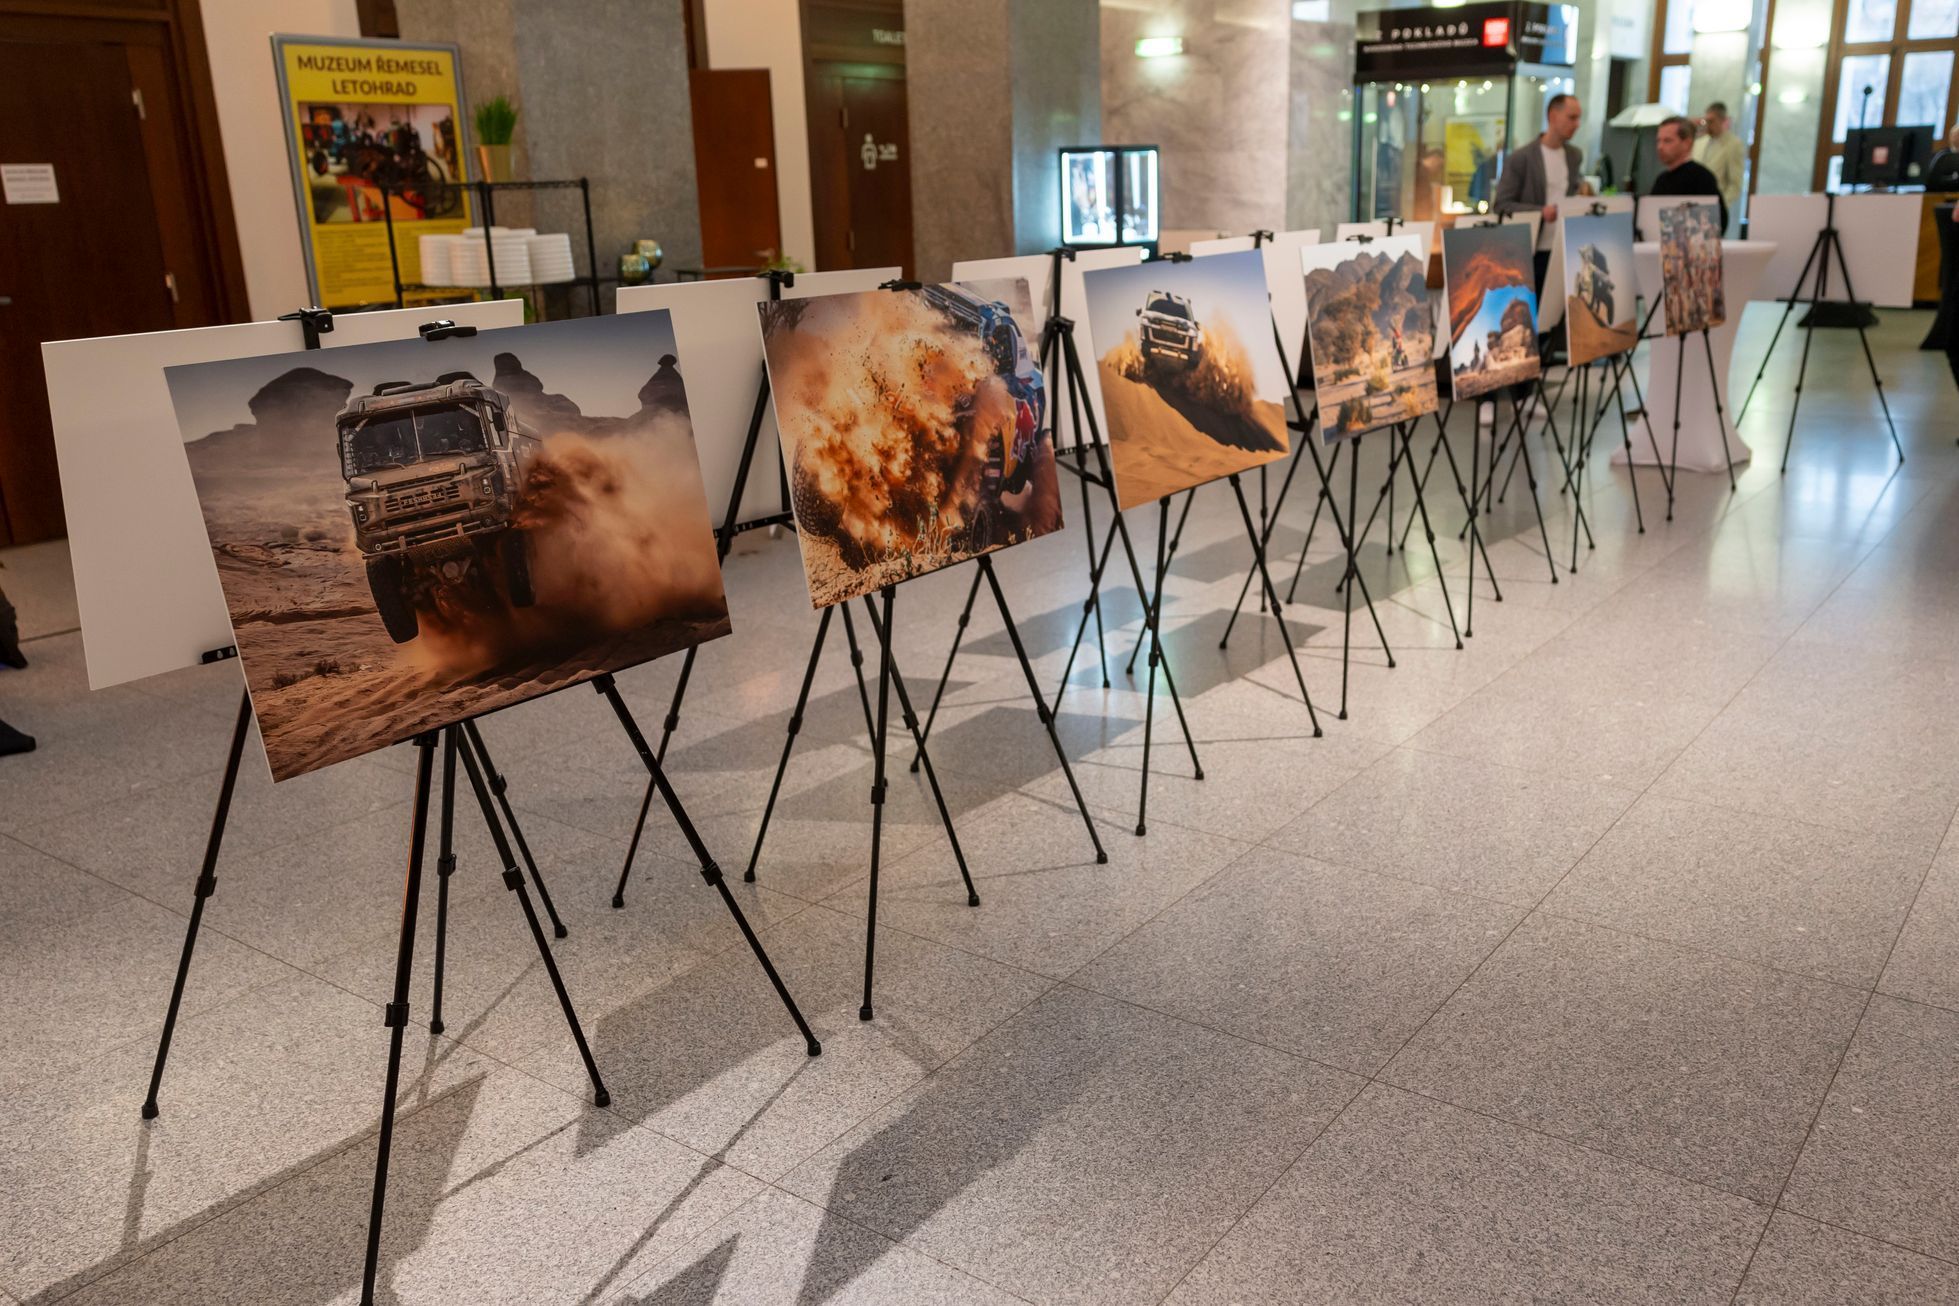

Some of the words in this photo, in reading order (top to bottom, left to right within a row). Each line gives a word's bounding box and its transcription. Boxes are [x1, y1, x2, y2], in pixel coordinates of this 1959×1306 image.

[297, 54, 373, 73] MUZEUM
[375, 54, 443, 76] ŘEMESEL
[331, 79, 417, 96] LETOHRAD
